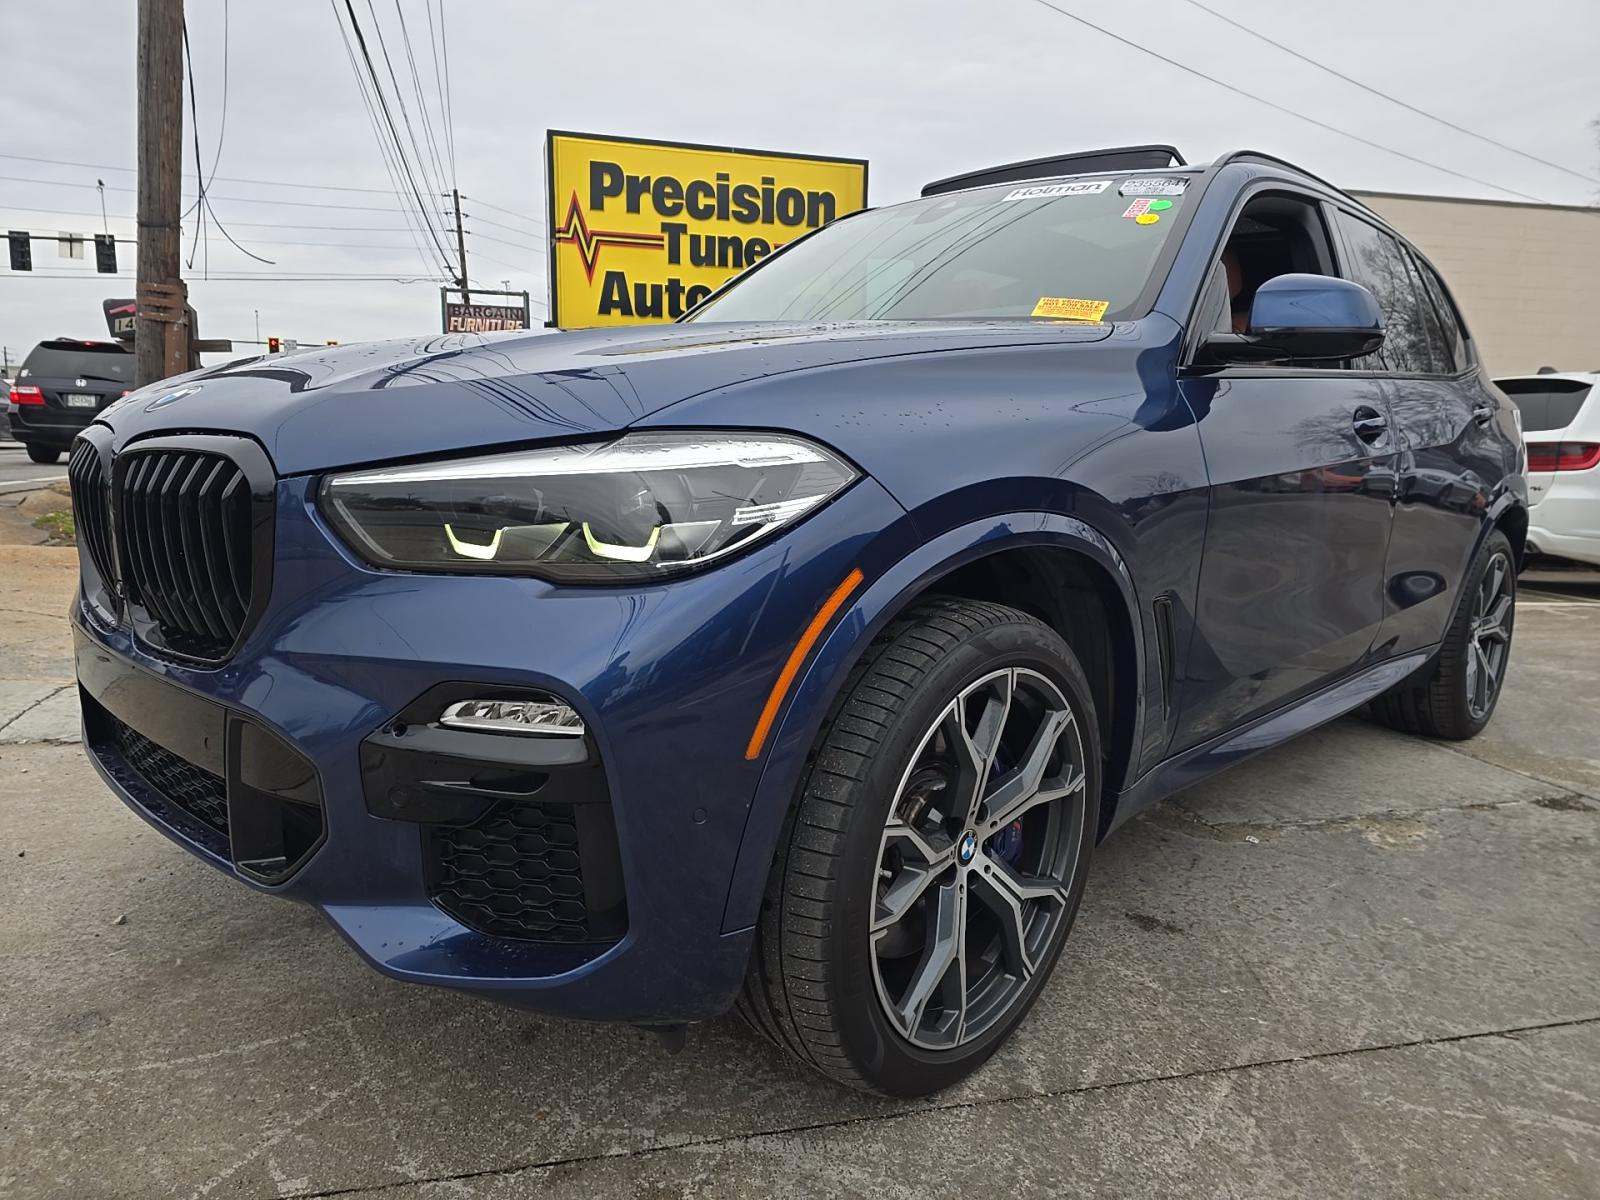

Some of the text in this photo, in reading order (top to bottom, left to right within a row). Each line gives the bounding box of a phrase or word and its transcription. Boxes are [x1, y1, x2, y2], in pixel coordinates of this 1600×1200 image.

[589, 160, 836, 228] Precision
[1009, 182, 1104, 198] Holman
[661, 221, 771, 269] Tune
[598, 271, 713, 319] Auto
[452, 305, 523, 320] BARGAIN
[118, 318, 137, 331] 14
[449, 316, 524, 332] FURNITURE
